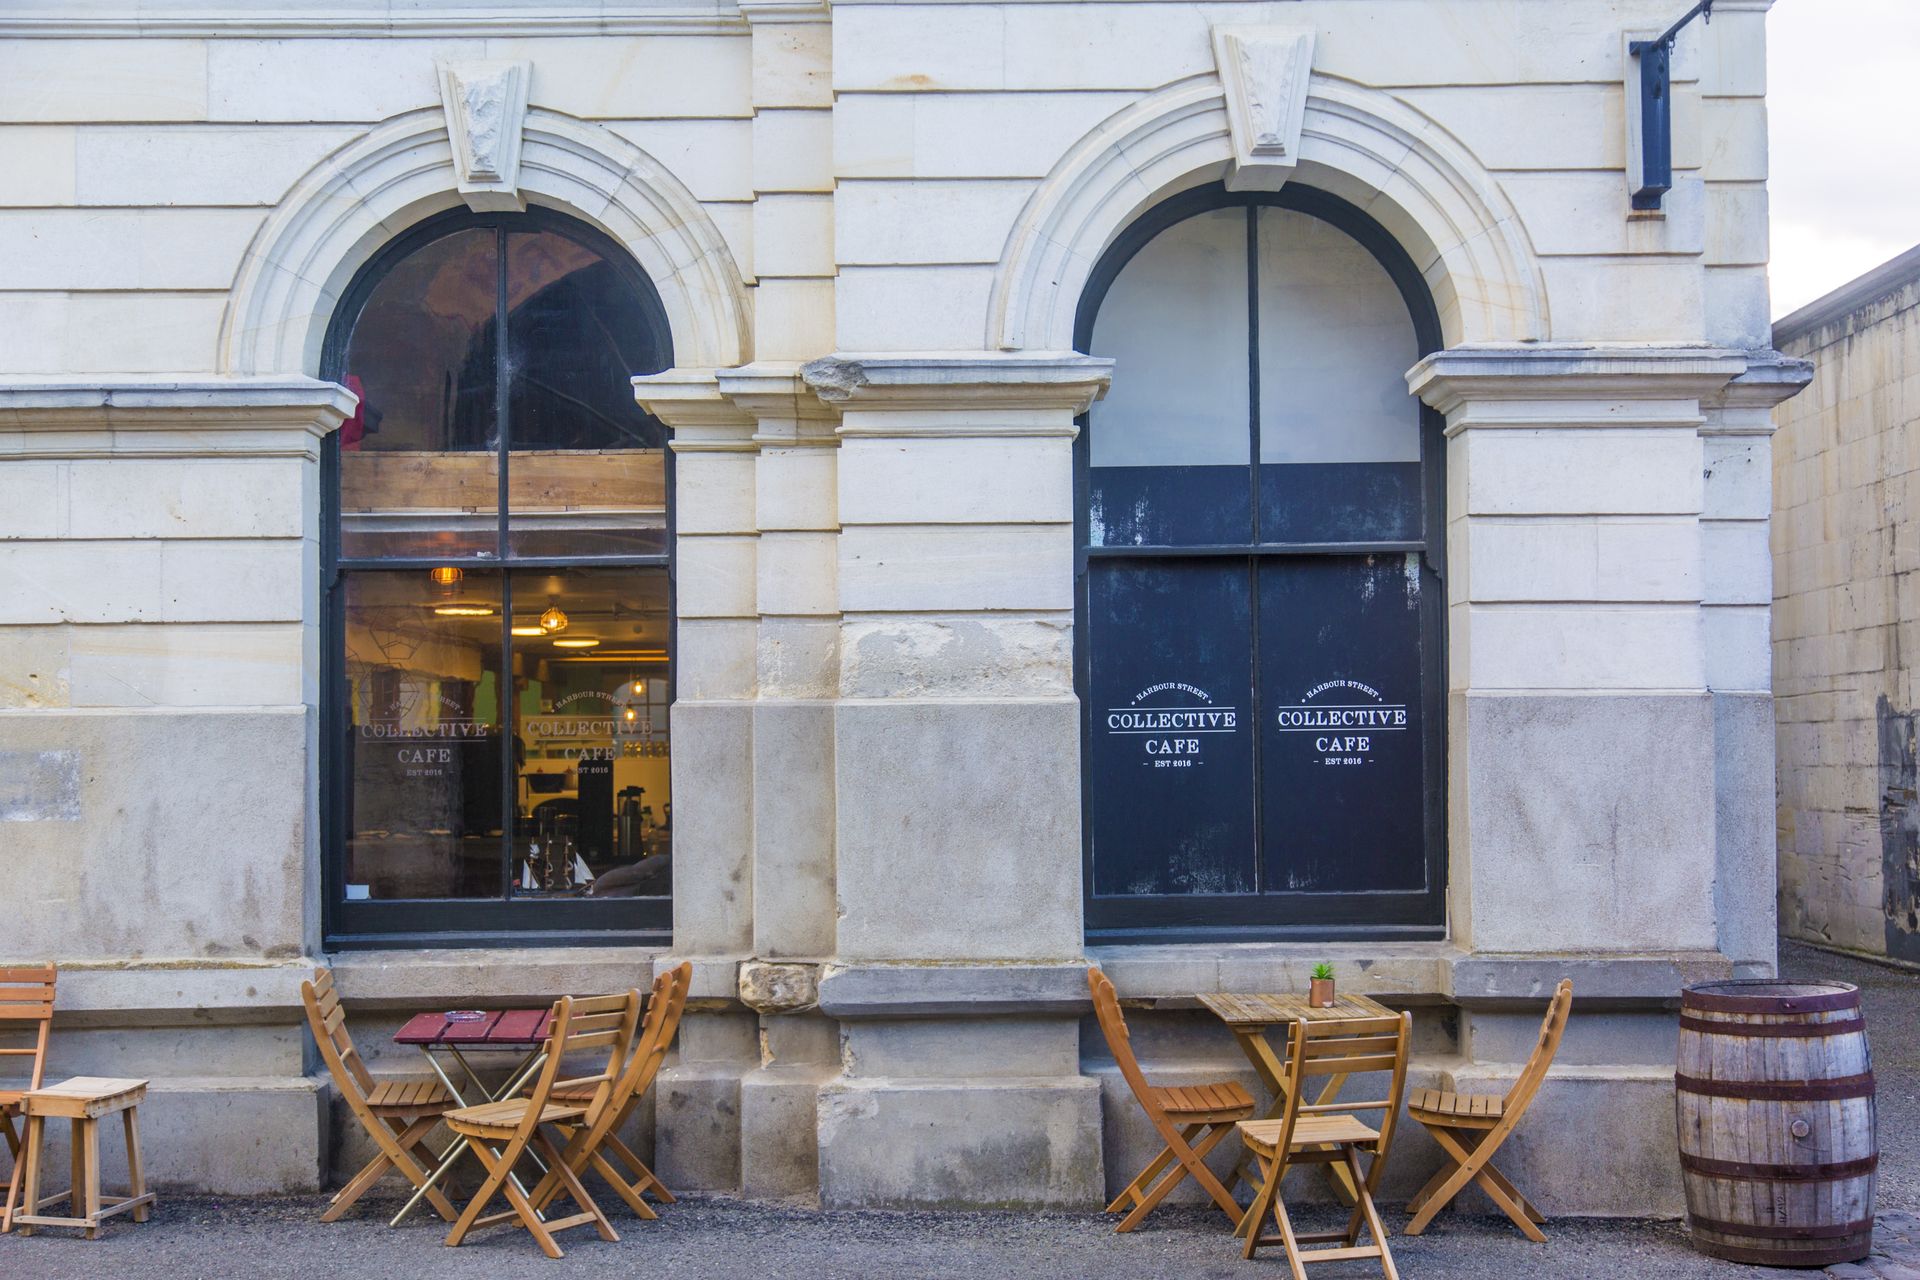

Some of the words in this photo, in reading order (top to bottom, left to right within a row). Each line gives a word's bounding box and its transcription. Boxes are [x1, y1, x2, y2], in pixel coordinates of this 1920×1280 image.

[1136, 682, 1176, 701] HARBOUR
[1177, 682, 1209, 700] STREET
[1306, 680, 1346, 699] HARBOUR
[1347, 680, 1379, 698] STREET
[1107, 712, 1237, 729] COLLECTIVE
[1278, 710, 1407, 726] COLLECTIVE
[527, 720, 654, 736] COLLECTIVE
[1145, 739, 1200, 754] CAFE
[1315, 736, 1370, 752] CAFE
[398, 748, 451, 763] CAFE
[564, 746, 616, 761] CAFE
[1325, 757, 1341, 765] EST
[1343, 757, 1362, 765] 2016
[591, 766, 609, 774] 2016
[1154, 760, 1171, 768] EST
[1173, 760, 1191, 768] 2016
[406, 769, 422, 777] EST
